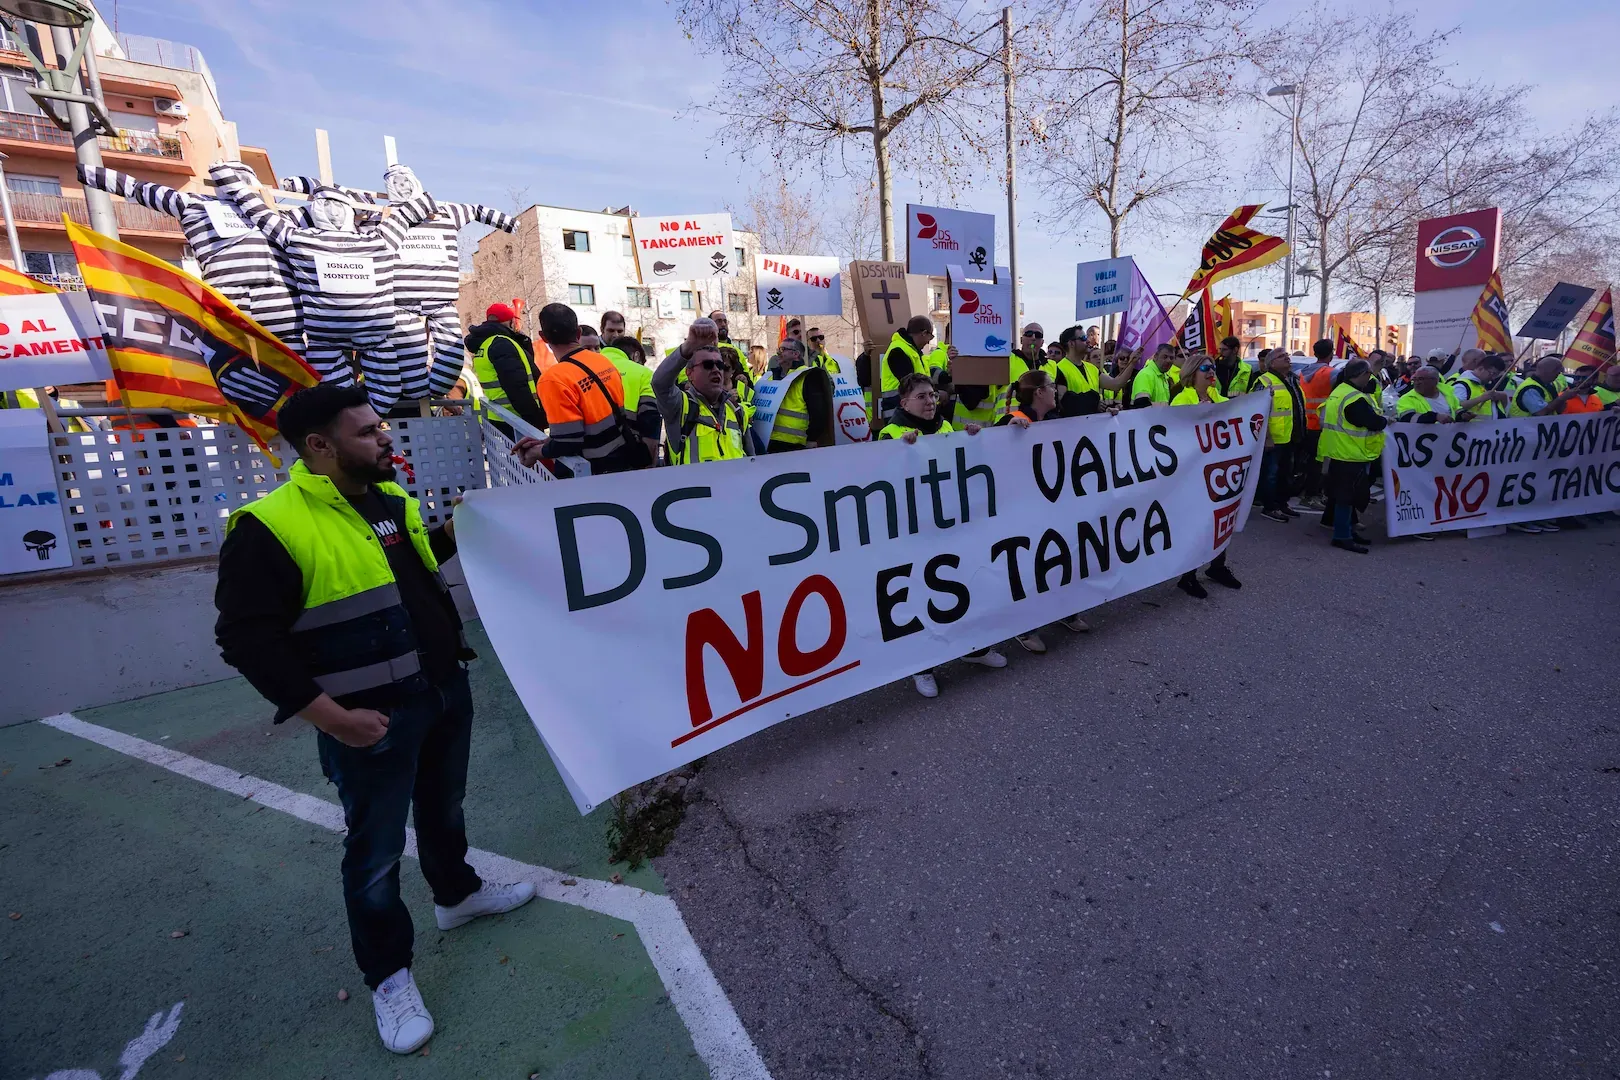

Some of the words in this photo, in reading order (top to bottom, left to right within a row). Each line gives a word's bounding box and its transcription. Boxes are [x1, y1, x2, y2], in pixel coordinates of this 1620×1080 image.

[660, 222, 680, 232] NO
[684, 220, 701, 231] AL
[640, 235, 724, 250] TANCAMENT
[938, 230, 951, 241] DS
[932, 238, 959, 251] Smith
[1430, 240, 1479, 255] NISSAN
[326, 262, 364, 270] IGNACIO
[762, 258, 831, 289] PIRATAS
[859, 264, 906, 280] DSSMITH
[323, 272, 370, 281] MONTFORT
[1095, 269, 1117, 281] VOLEM
[1093, 283, 1117, 295] SEGUIR
[1085, 294, 1124, 309] TREBALLANT
[980, 304, 993, 315] DS
[973, 312, 1002, 325] Smith
[21, 319, 57, 334] AL
[0, 336, 105, 360] CAMENT
[836, 377, 848, 385] AL
[833, 386, 863, 398] AMENT
[844, 417, 866, 428] STOP
[1195, 417, 1244, 454] UGT
[1394, 432, 1438, 468] DS
[1444, 427, 1526, 468] Smith
[1400, 490, 1412, 506] DS
[1434, 471, 1490, 521] NO
[1496, 472, 1537, 508] ES
[1548, 461, 1620, 502] TANC
[554, 486, 723, 612] DS
[760, 447, 996, 566] Smith
[1032, 424, 1178, 504] VALLS
[685, 574, 848, 728] NO
[876, 554, 972, 643] ES
[990, 500, 1172, 602] TANCA
